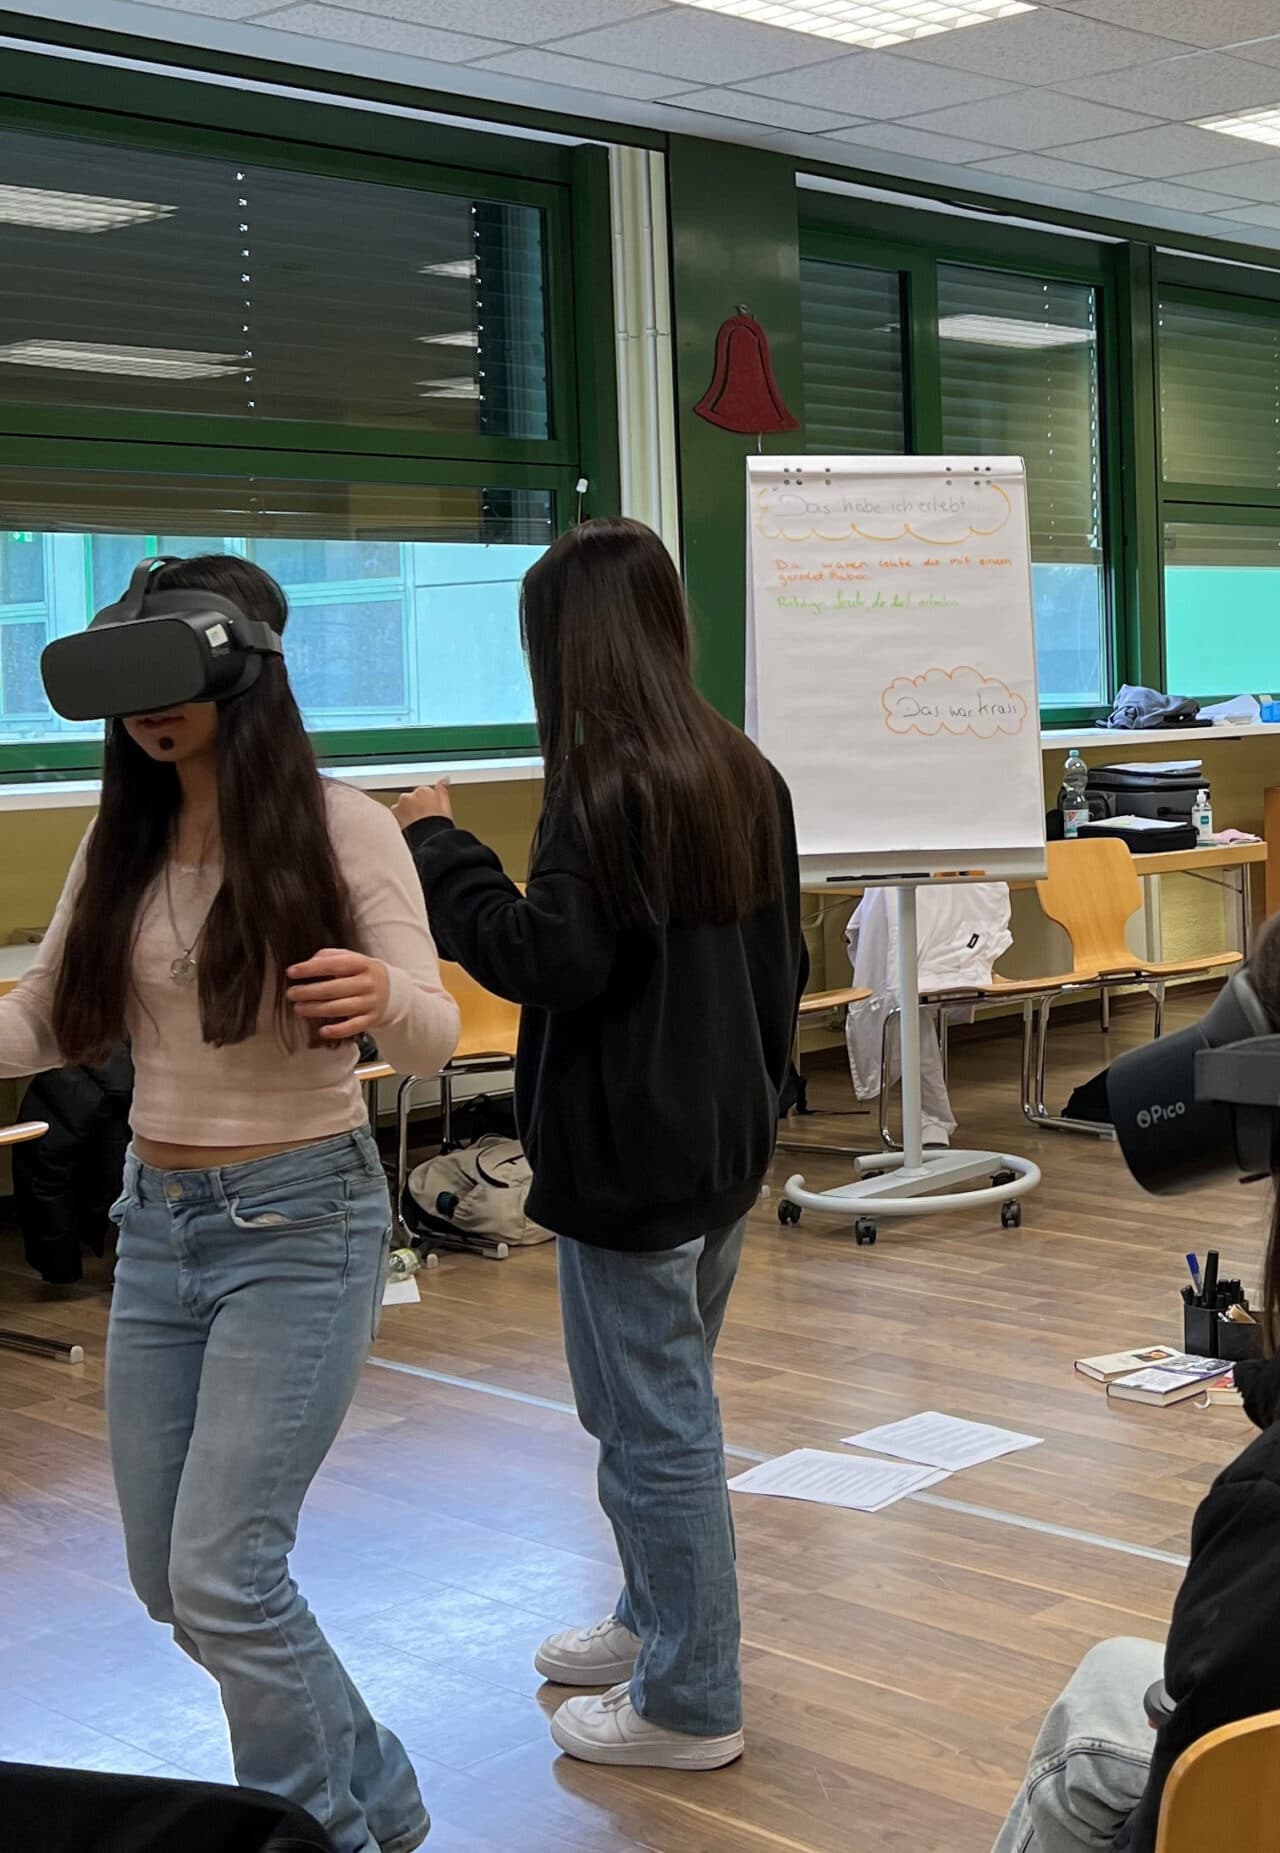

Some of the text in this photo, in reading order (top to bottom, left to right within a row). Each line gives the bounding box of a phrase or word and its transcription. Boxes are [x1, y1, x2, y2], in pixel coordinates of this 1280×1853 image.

[775, 494, 832, 516] Das
[842, 495, 882, 513] habe
[891, 495, 913, 512] ich
